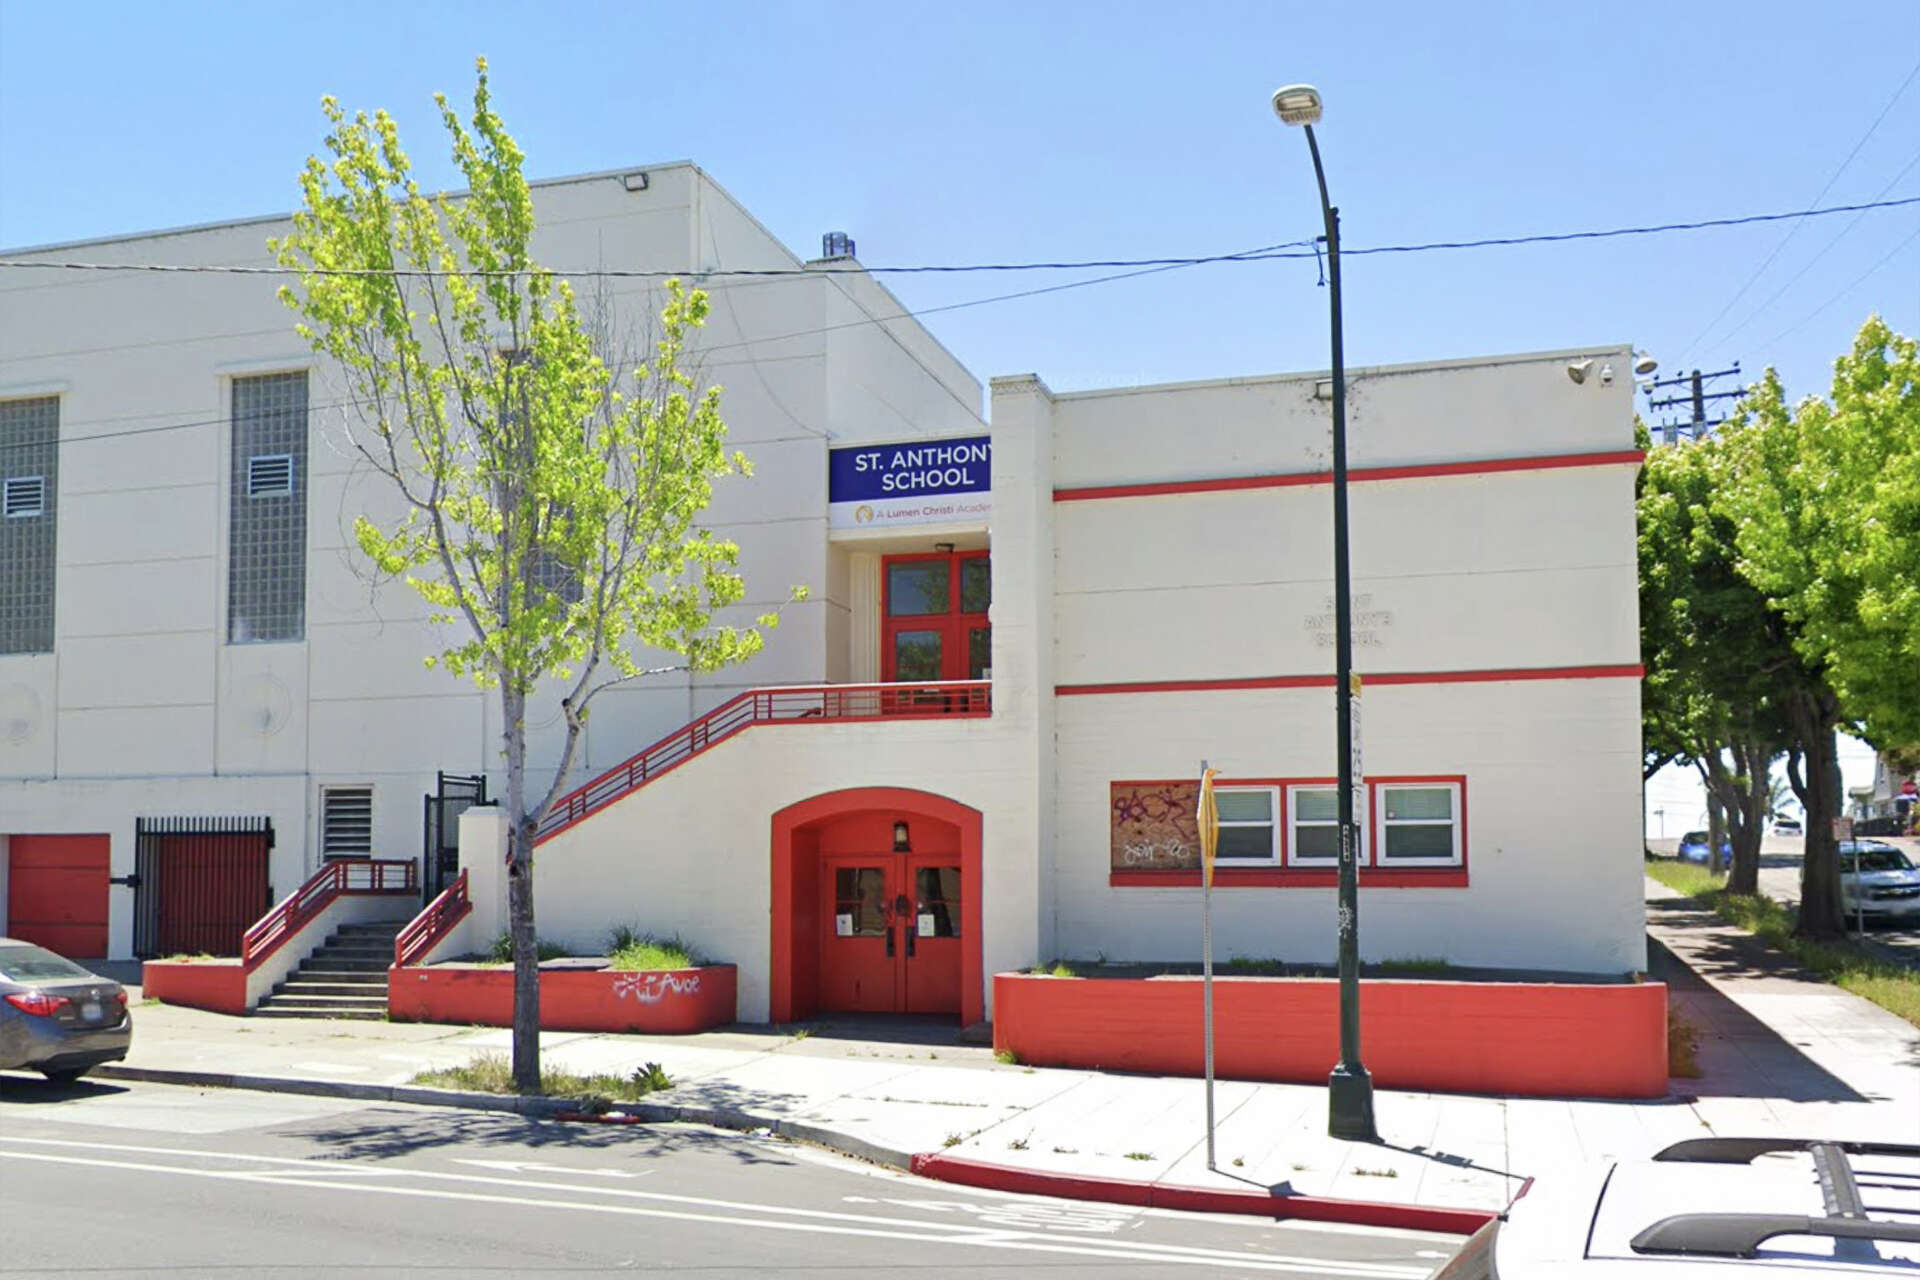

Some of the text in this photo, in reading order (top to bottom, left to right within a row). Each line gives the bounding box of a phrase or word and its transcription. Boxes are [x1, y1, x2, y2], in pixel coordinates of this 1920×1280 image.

[855, 444, 992, 471] ST. ANTHON
[882, 467, 975, 491] SCHOOL
[887, 508, 920, 518] Lumen
[922, 505, 954, 516] Christi
